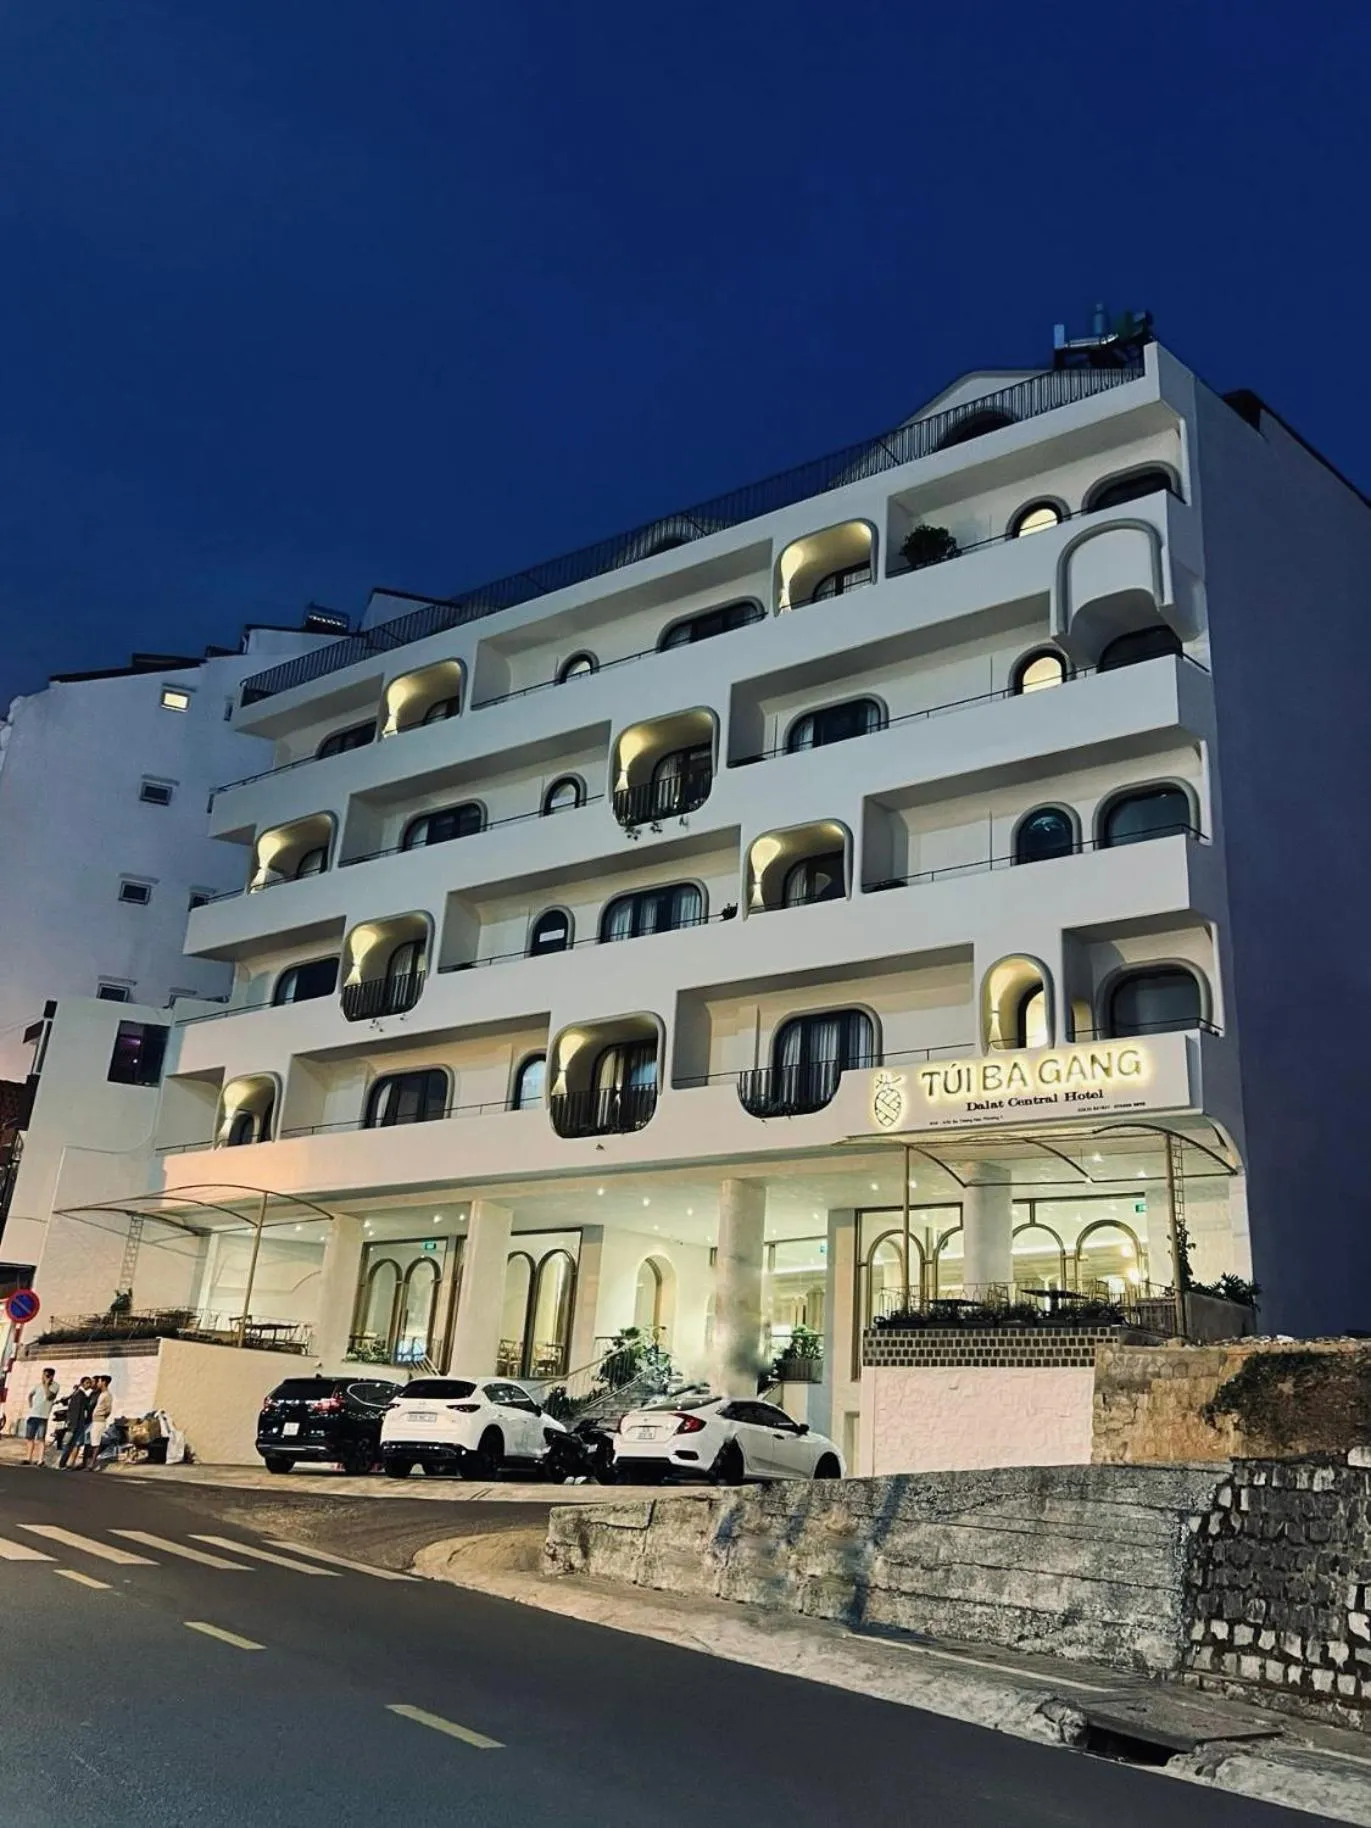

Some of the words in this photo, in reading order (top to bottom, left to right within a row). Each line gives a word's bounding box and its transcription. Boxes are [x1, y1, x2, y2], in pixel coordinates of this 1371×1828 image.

[921, 1063, 971, 1097] TÚI
[982, 1062, 1029, 1091] BA
[1038, 1049, 1141, 1085] GANG
[966, 1099, 1004, 1112] Dalat
[1007, 1093, 1058, 1107] Central
[1064, 1089, 1104, 1101] Hotel
